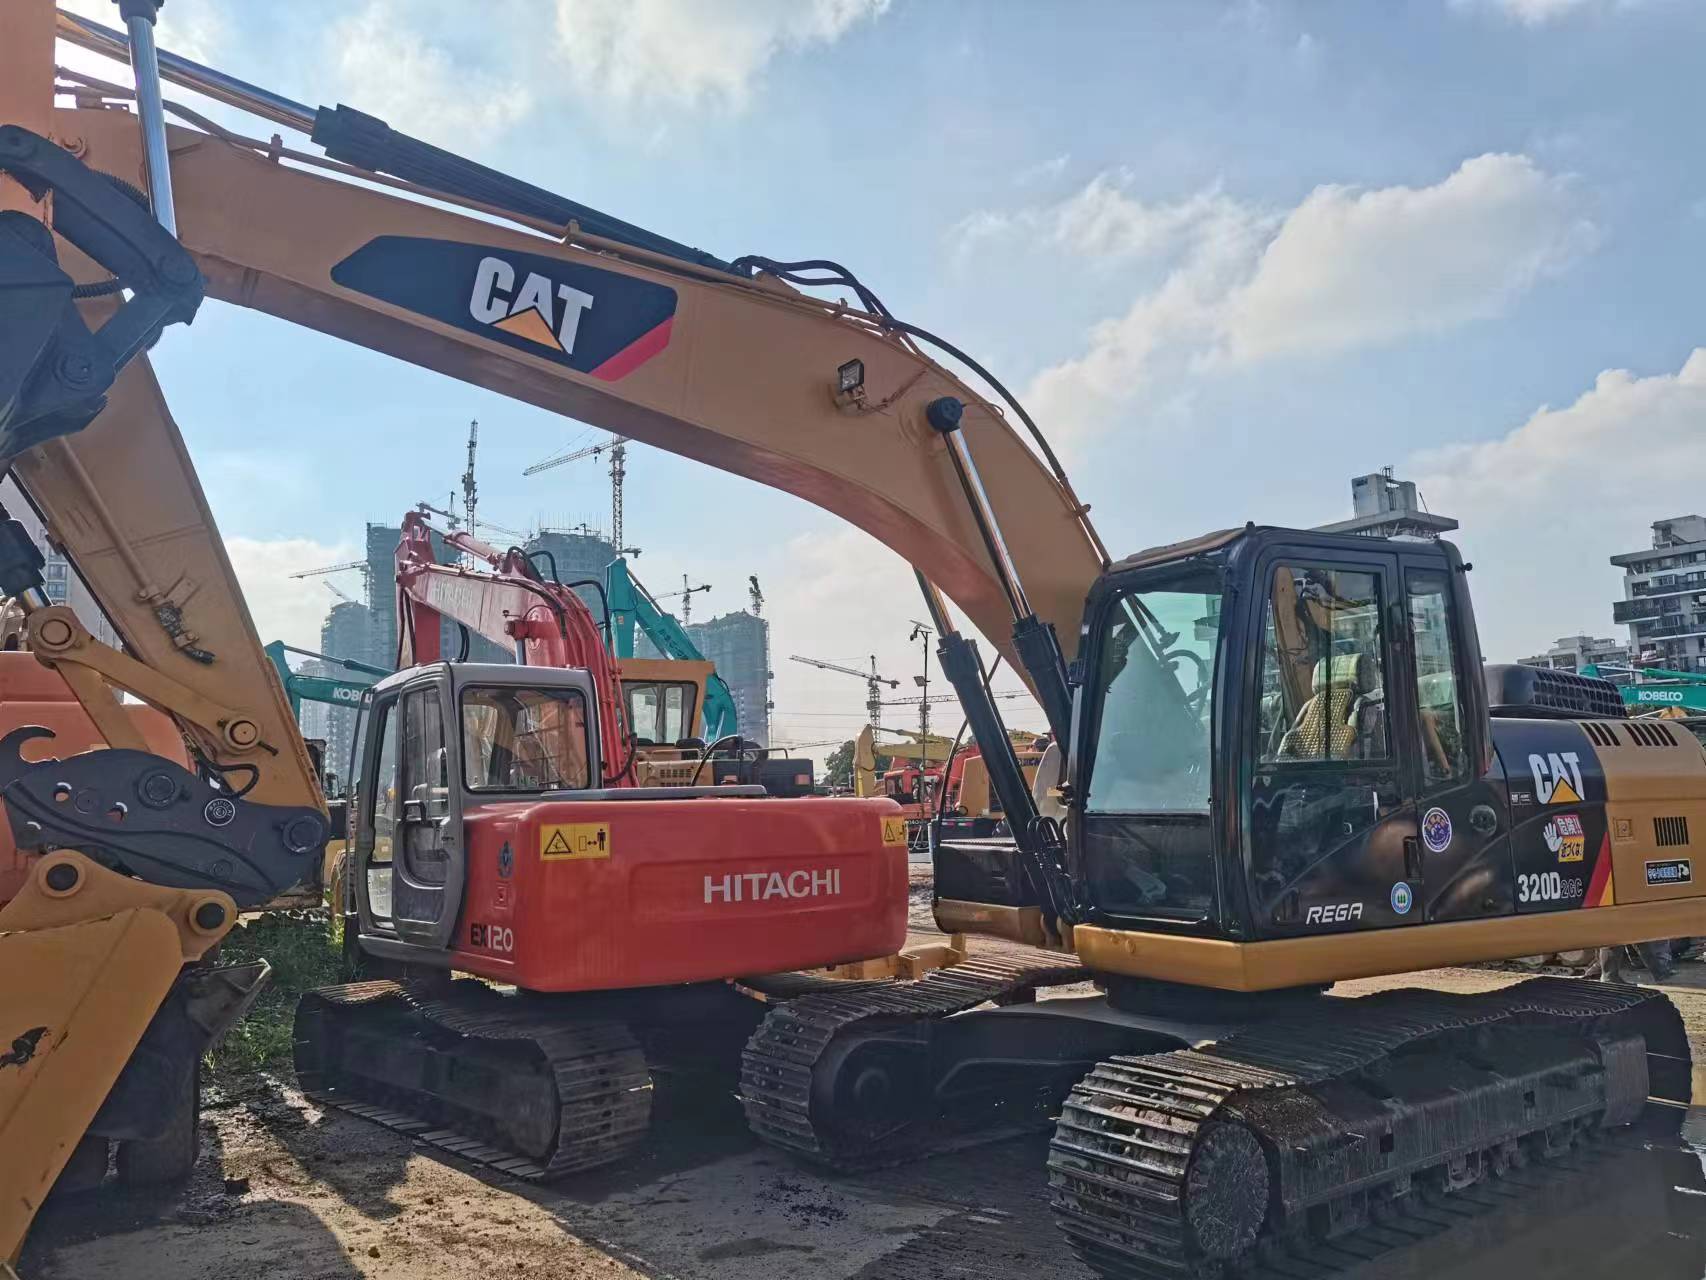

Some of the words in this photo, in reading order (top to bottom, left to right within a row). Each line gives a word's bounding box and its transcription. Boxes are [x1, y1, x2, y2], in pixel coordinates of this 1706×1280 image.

[470, 257, 594, 355] CAT
[1638, 691, 1683, 701] KOBELCO
[1528, 752, 1585, 804] CAT
[704, 869, 840, 903] HITACHI
[1305, 902, 1363, 925] REGA
[471, 924, 514, 952] EX120
